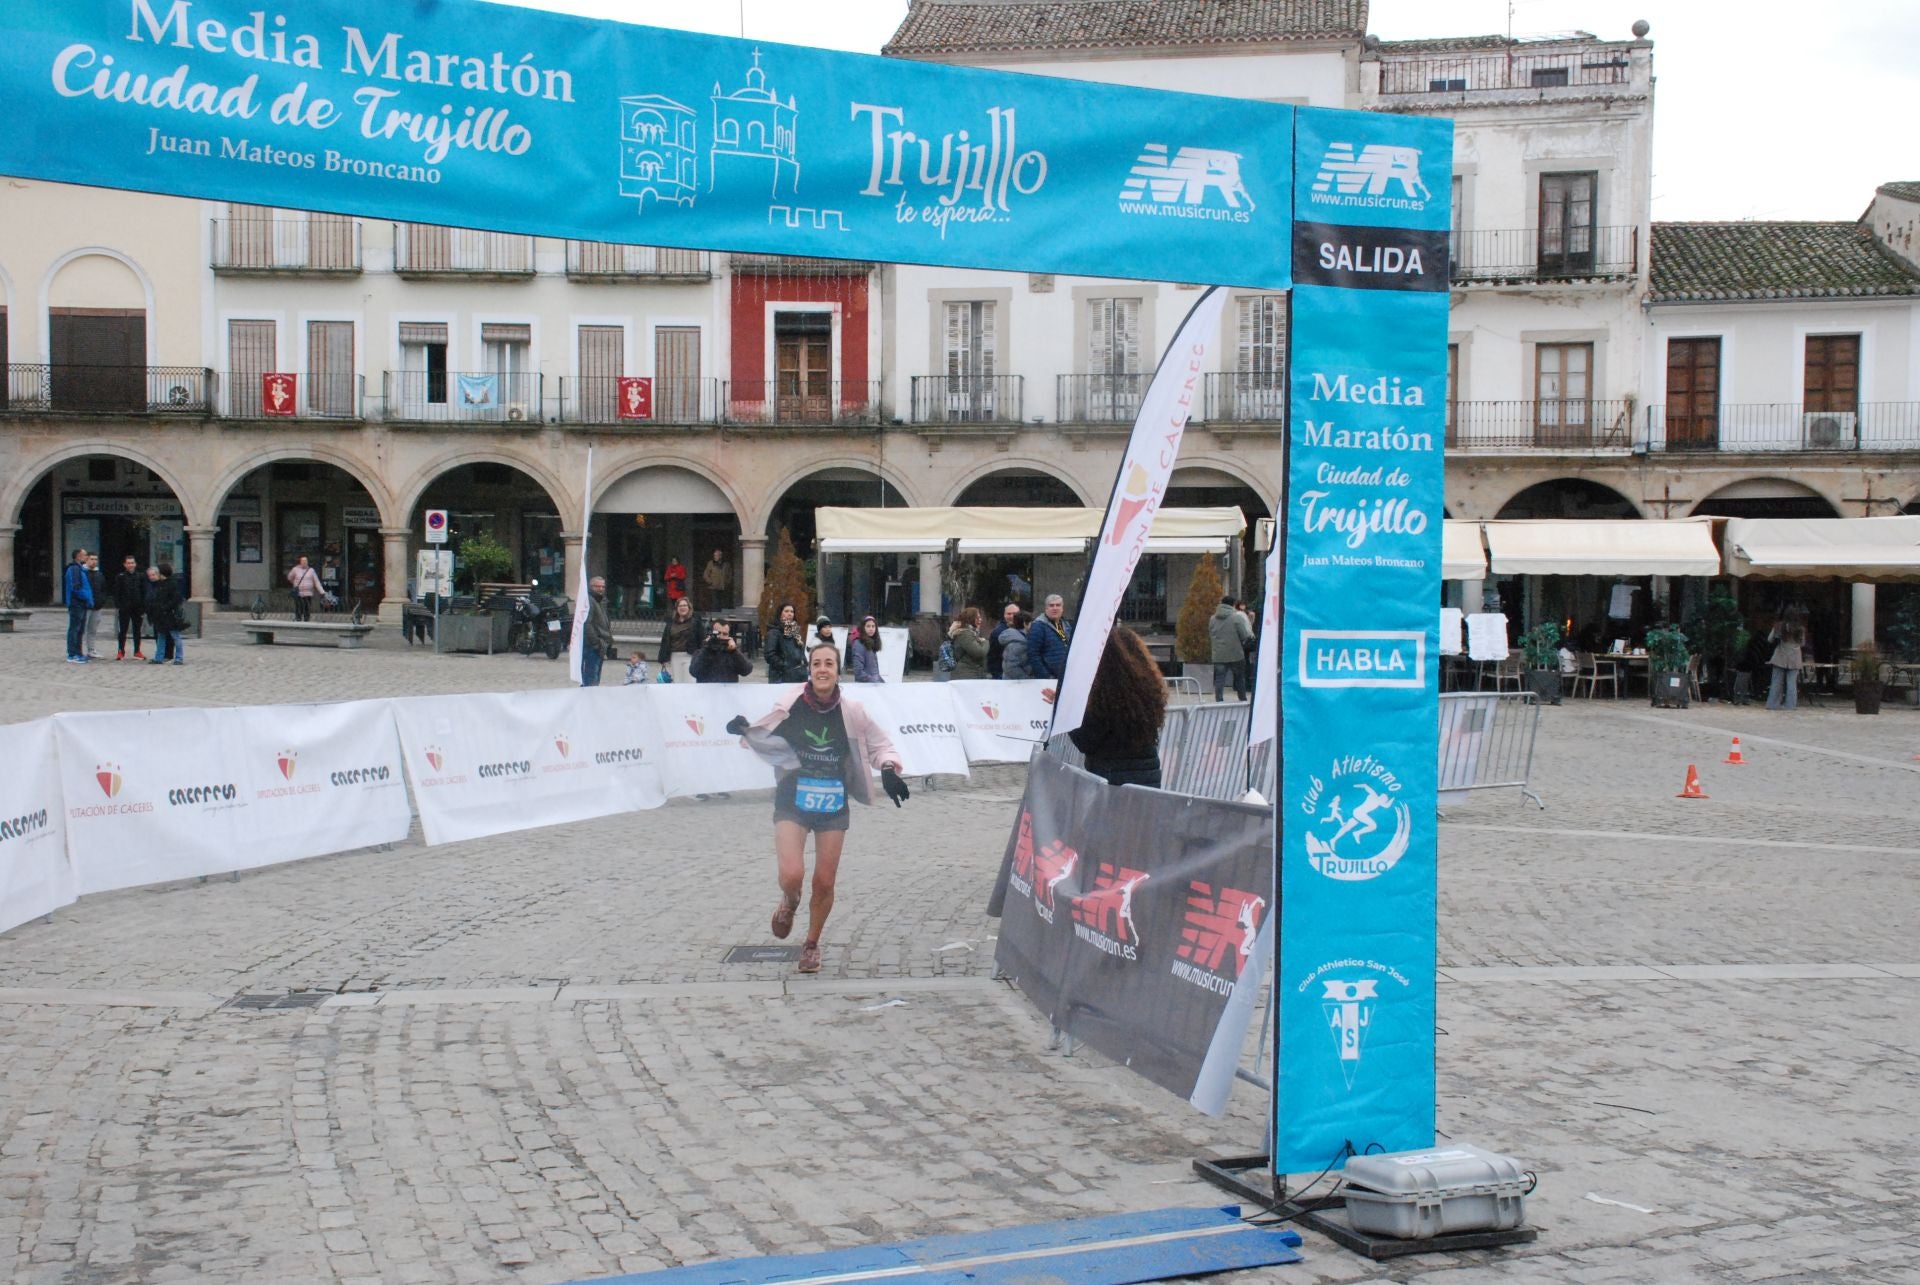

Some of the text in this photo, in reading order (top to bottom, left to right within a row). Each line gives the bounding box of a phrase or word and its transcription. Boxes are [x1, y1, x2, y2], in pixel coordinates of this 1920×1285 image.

[126, 0, 576, 103] Media Maratón
[51, 43, 532, 164] Ciudad de Trujillo
[147, 127, 442, 184] Juan Mateos Broncano
[850, 101, 1048, 213] Trujillo
[896, 189, 919, 224] te
[1119, 201, 1250, 224] www.musicrun.es
[1311, 191, 1425, 212] www.musicrun.es
[1319, 242, 1424, 276] SALIDA
[1311, 372, 1425, 407] Media
[1303, 420, 1434, 452] Maratón
[1317, 461, 1412, 487] Ciudad de
[1300, 490, 1428, 549] Trujillo
[1303, 554, 1425, 569] Juan Mateos Broncano
[1316, 647, 1406, 672] HABLA
[804, 793, 836, 810] 572
[1301, 754, 1402, 815] Club Atletismo
[1073, 921, 1137, 961] www.musicrun.es
[1171, 959, 1235, 997] www.musicrun
[1298, 972, 1316, 992] Club
[1367, 960, 1387, 972] San
[1387, 966, 1410, 987] José
